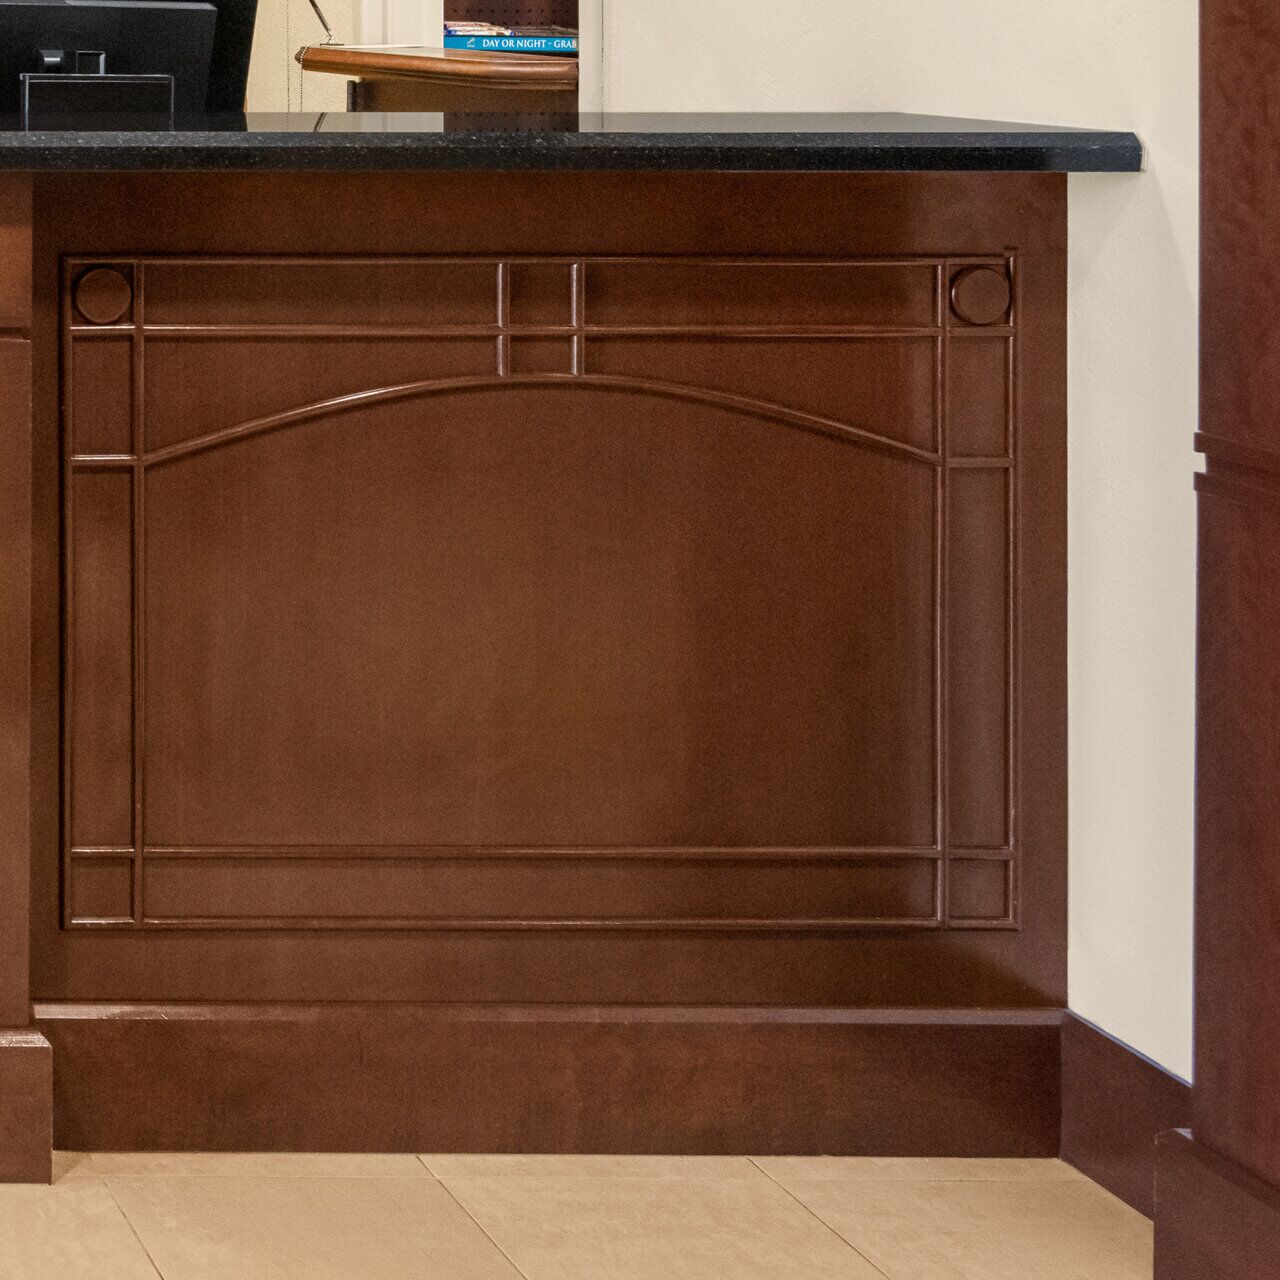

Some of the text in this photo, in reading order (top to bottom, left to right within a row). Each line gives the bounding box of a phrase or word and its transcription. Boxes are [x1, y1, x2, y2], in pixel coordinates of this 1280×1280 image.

[482, 39, 500, 48] DAY
[501, 39, 515, 48] OR
[516, 39, 546, 49] NIGHT
[553, 40, 577, 49] GRAB
